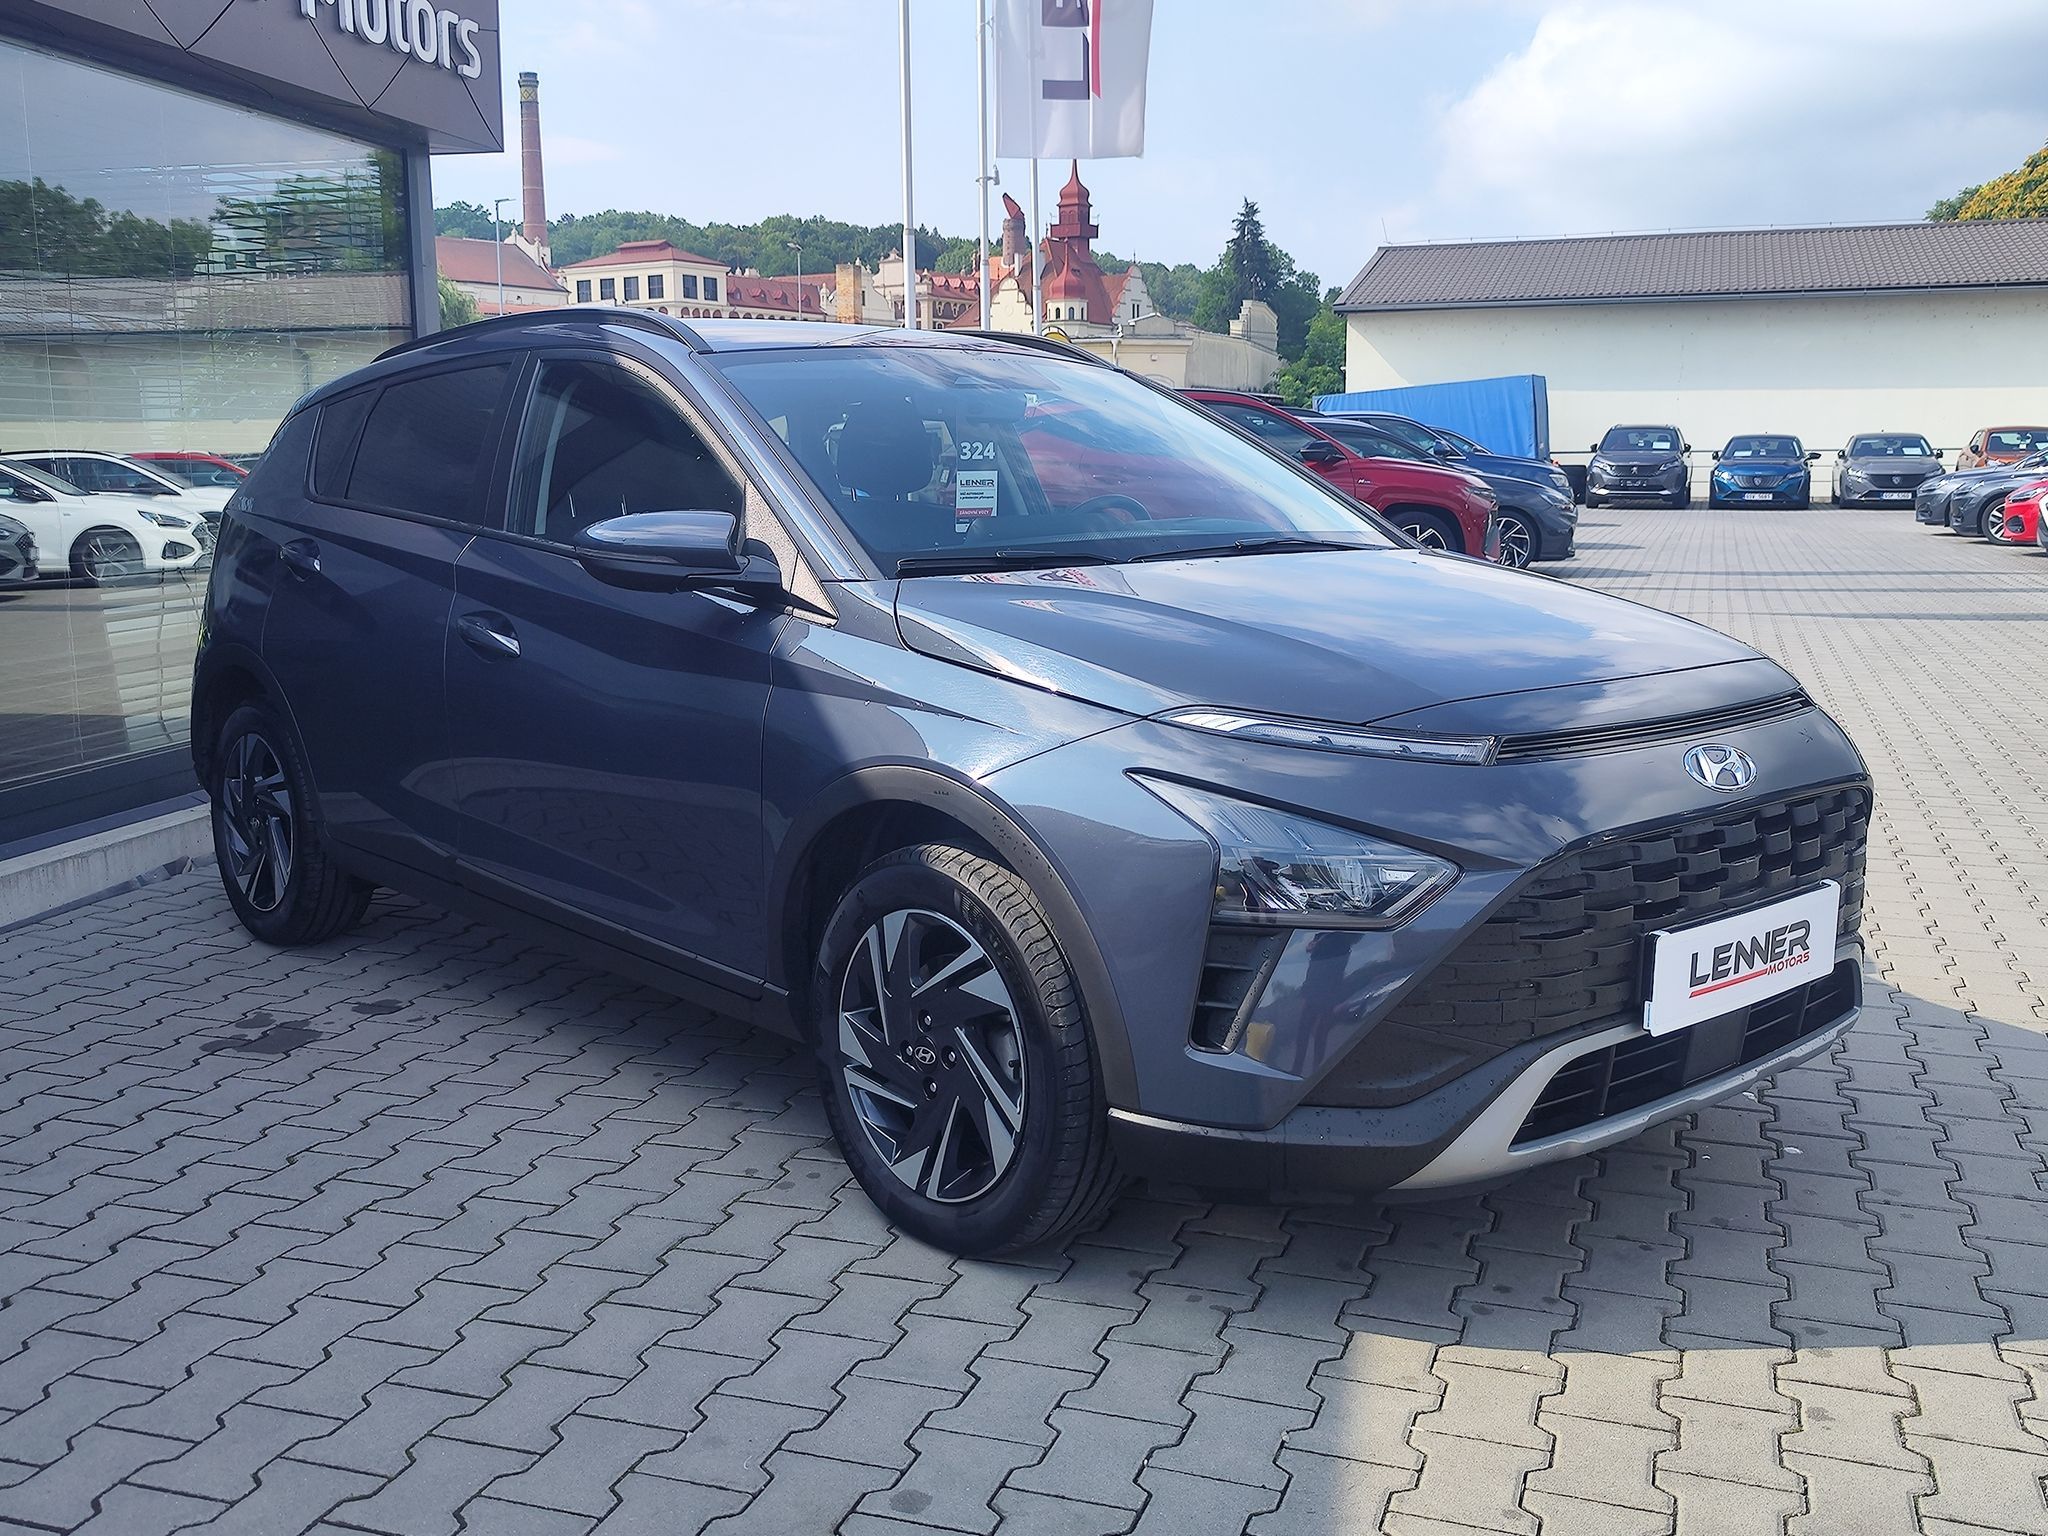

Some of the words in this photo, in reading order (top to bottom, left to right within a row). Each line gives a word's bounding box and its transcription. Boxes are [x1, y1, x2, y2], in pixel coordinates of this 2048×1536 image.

[960, 441, 996, 460] 324
[960, 479, 995, 487] LENNER
[1689, 919, 1811, 988] LENNER
[1767, 951, 1810, 976] MOTORS
